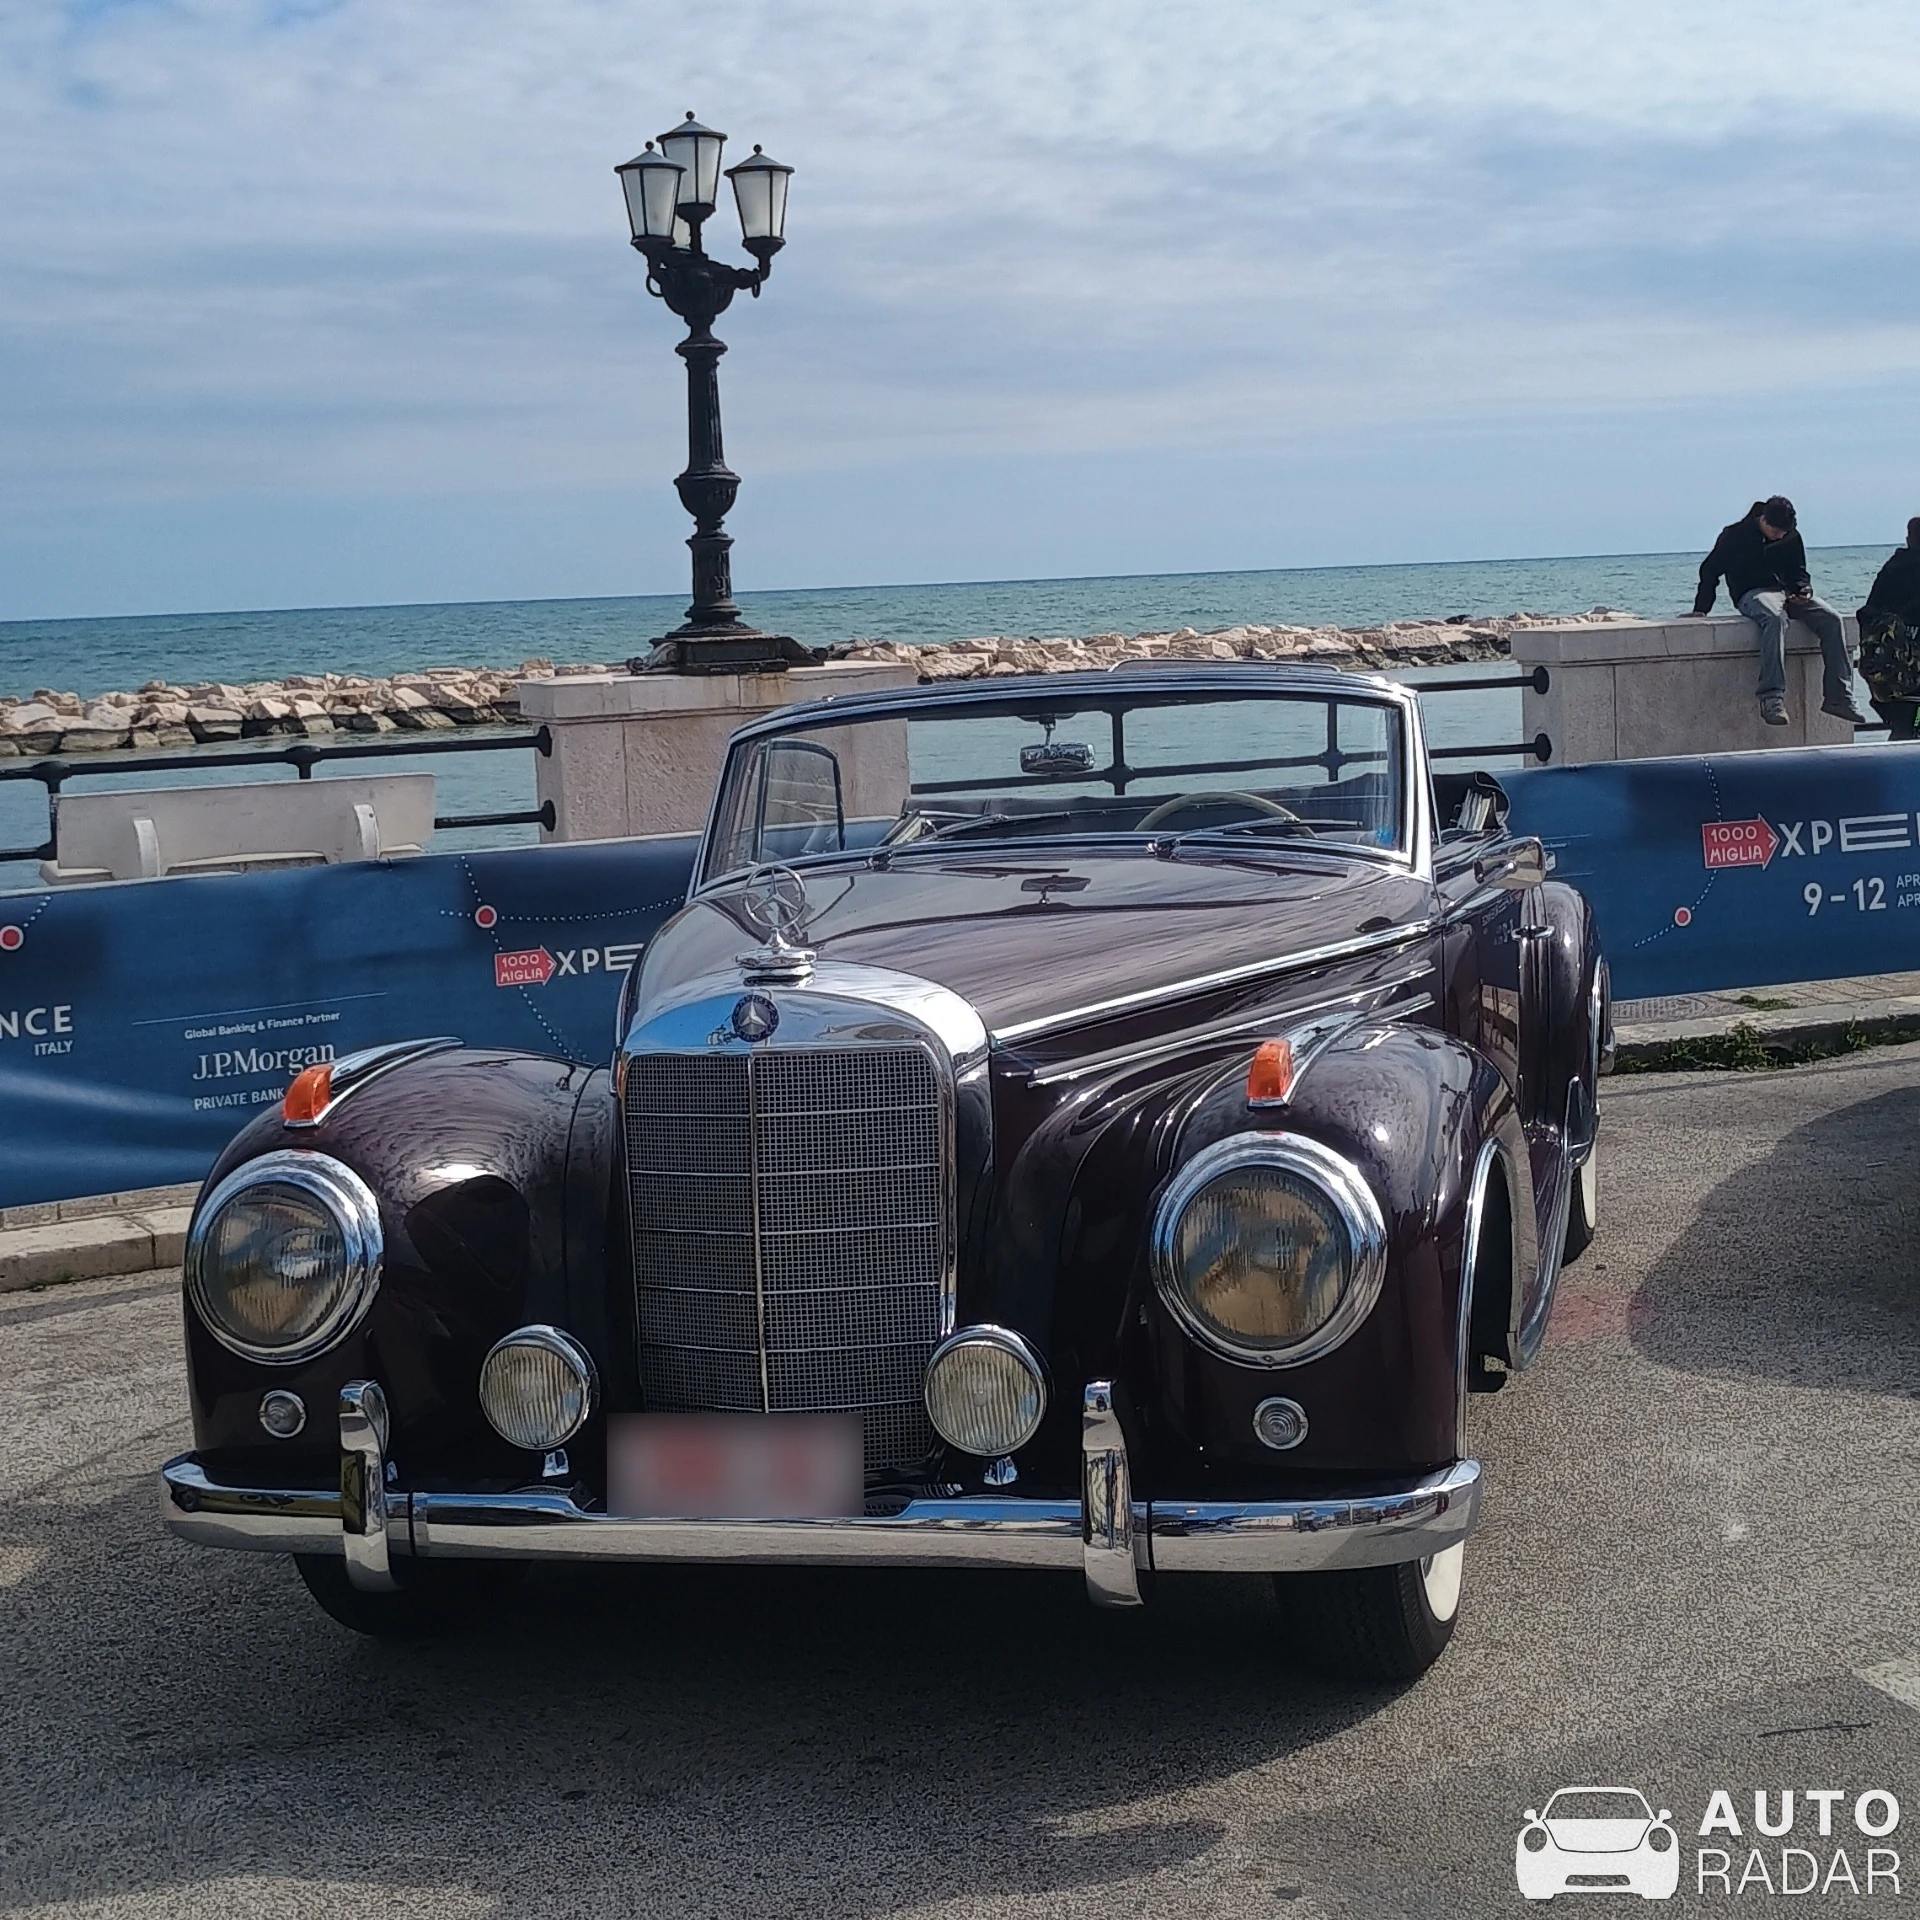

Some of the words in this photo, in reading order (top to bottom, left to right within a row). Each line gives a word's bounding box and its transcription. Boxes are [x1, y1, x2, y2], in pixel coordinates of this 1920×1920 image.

[1711, 826, 1757, 842] 1000
[1779, 812, 1920, 857] XPE
[1710, 845, 1763, 863] MIGLIA
[501, 953, 540, 968] 1000
[500, 967, 543, 983] MIGLIA
[184, 1026, 217, 1040] Global
[218, 1022, 257, 1034] Banking
[257, 1020, 265, 1030] &
[267, 1015, 304, 1029] Finance
[305, 1012, 341, 1024] Partner
[34, 1040, 73, 1056] ITALY
[192, 1043, 336, 1080] J.P.Morgan
[194, 1092, 248, 1111] PRIVATE
[251, 1087, 285, 1104] BANK
